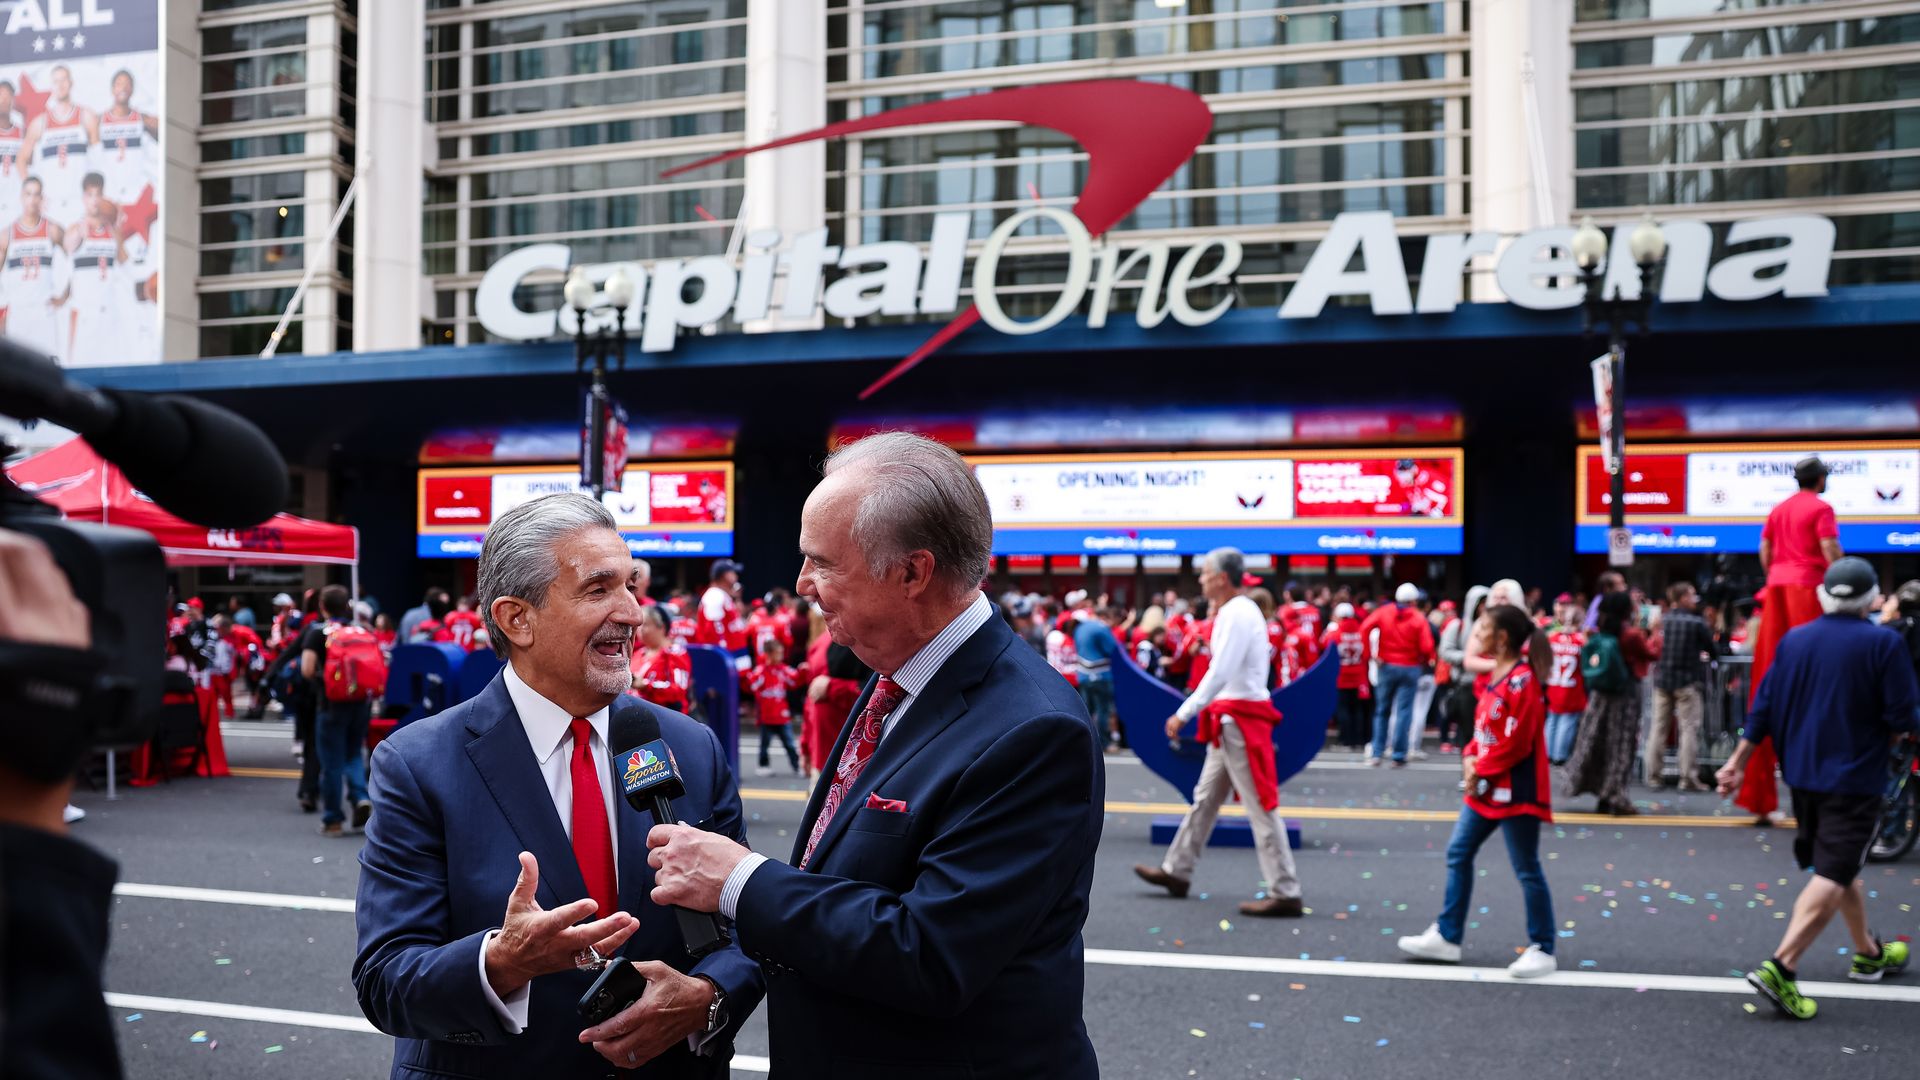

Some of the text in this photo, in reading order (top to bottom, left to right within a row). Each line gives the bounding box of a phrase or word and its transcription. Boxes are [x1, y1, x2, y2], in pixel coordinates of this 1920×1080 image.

[2, 0, 115, 34] ALL
[475, 207, 1837, 352] Capital One Arena
[1057, 469, 1139, 489] OPENING
[623, 760, 666, 785] Sports
[625, 769, 670, 792] WASHINGTON
